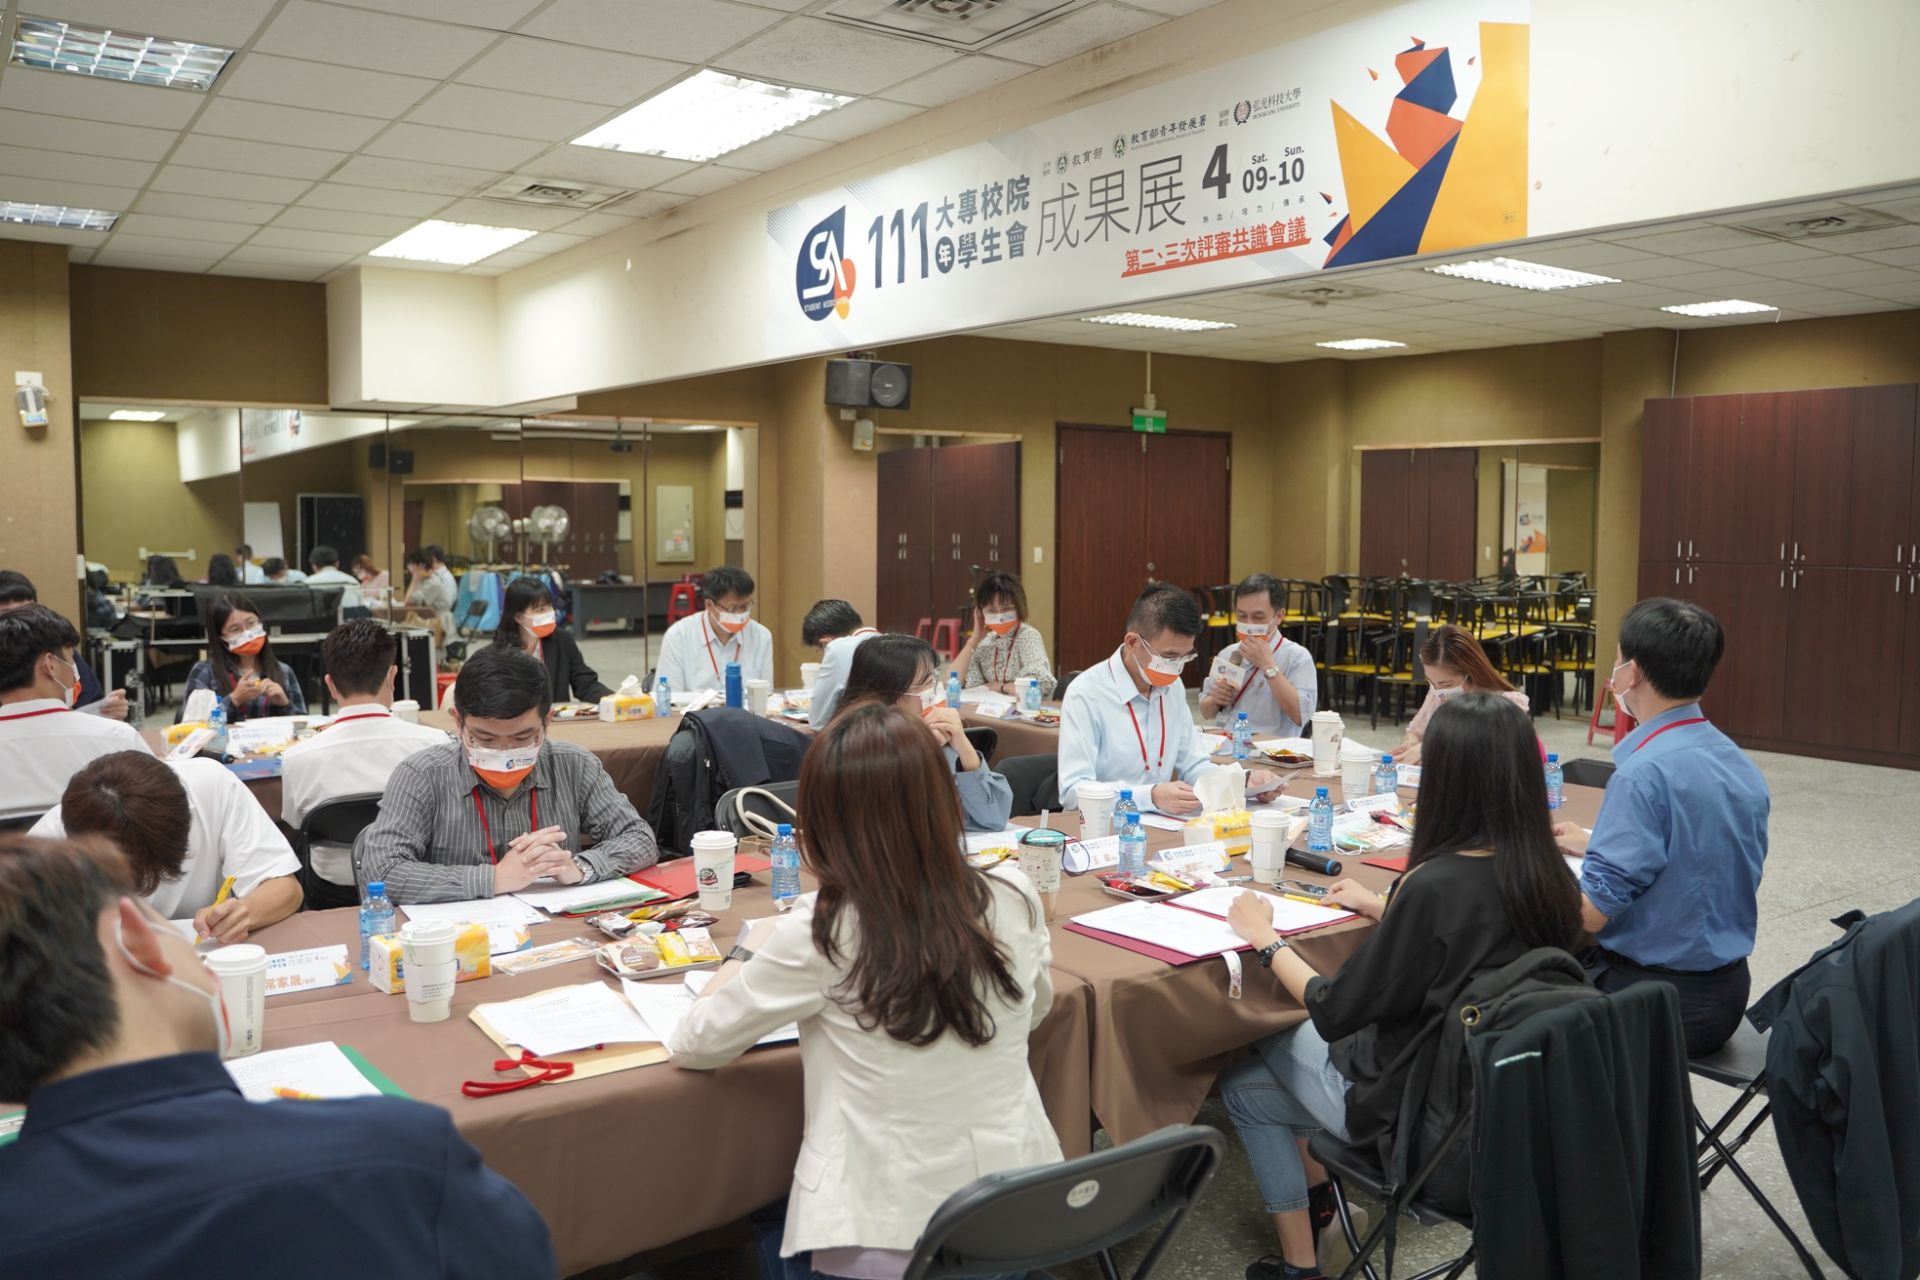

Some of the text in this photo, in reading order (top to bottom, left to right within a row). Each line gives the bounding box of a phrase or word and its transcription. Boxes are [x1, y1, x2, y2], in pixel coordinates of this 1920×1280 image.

[1131, 113, 1206, 144] 教育部青年發展署
[1251, 145, 1305, 164] Sat. Sun.
[1072, 147, 1103, 167] 教育部
[1202, 143, 1231, 199] 4
[1242, 157, 1305, 194] 09-10
[935, 174, 1031, 232] 大專校院
[1037, 154, 1186, 256] 成果展
[868, 201, 928, 289] 111
[1125, 216, 1307, 272] 第二、三次評審共識會議
